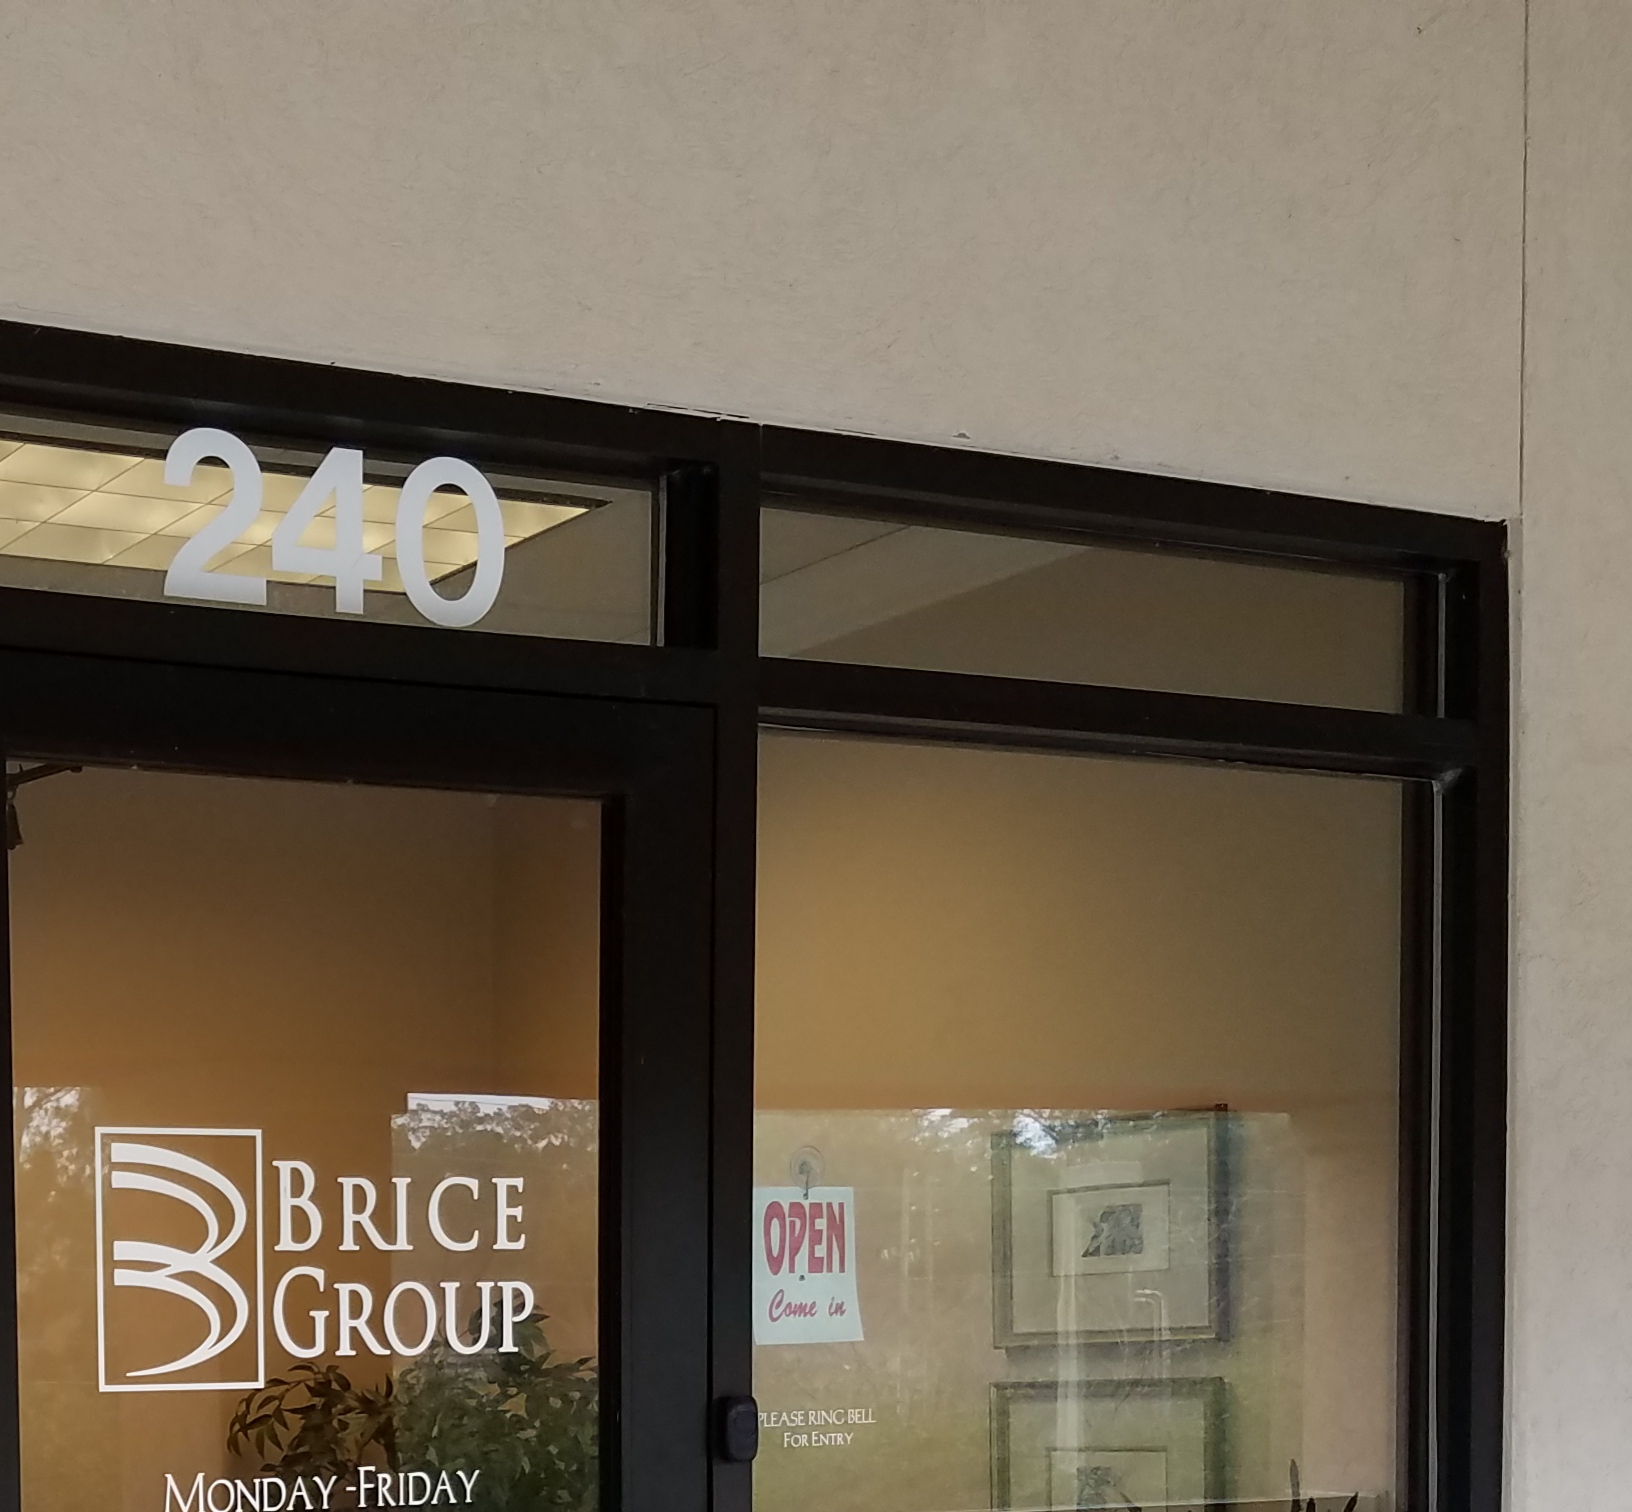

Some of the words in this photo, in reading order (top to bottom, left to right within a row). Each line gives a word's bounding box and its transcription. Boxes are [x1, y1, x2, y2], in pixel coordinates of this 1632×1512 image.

[164, 427, 505, 628] 240
[272, 1160, 526, 1251] BRICE
[763, 1201, 846, 1276] OPEN
[273, 1266, 535, 1358] GROUP
[768, 1289, 817, 1322] Come
[828, 1297, 846, 1316] in
[758, 1411, 806, 1427] PLEASE
[808, 1410, 845, 1425] RING
[847, 1408, 876, 1424] BELL
[783, 1432, 809, 1448] FOR
[811, 1431, 854, 1446] ENTRY
